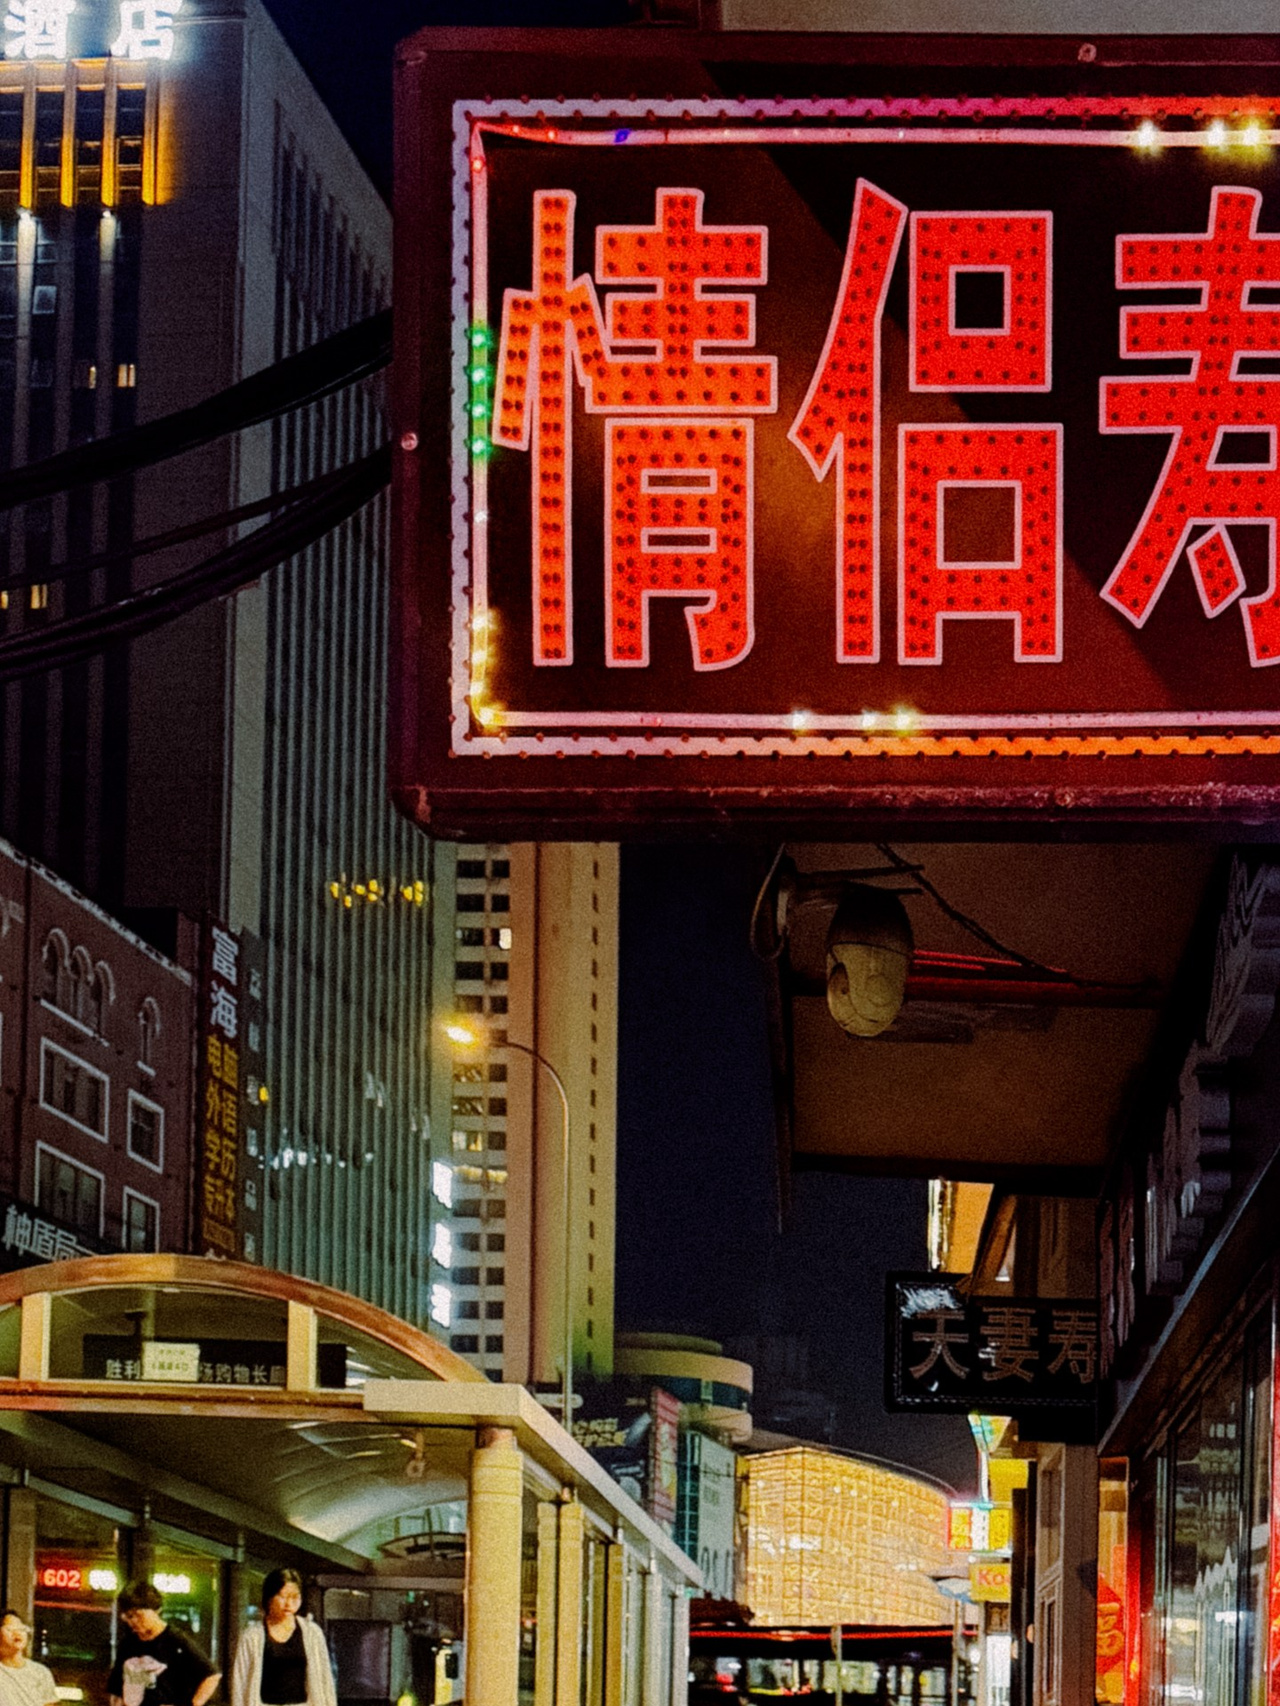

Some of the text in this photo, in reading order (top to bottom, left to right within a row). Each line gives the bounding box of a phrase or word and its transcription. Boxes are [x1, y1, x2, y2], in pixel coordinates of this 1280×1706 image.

[3, 0, 182, 61] 酒店
[909, 1304, 1098, 1384] 夫妻寿
[43, 1568, 81, 1588] 602
[978, 1568, 1010, 1588] Ko
